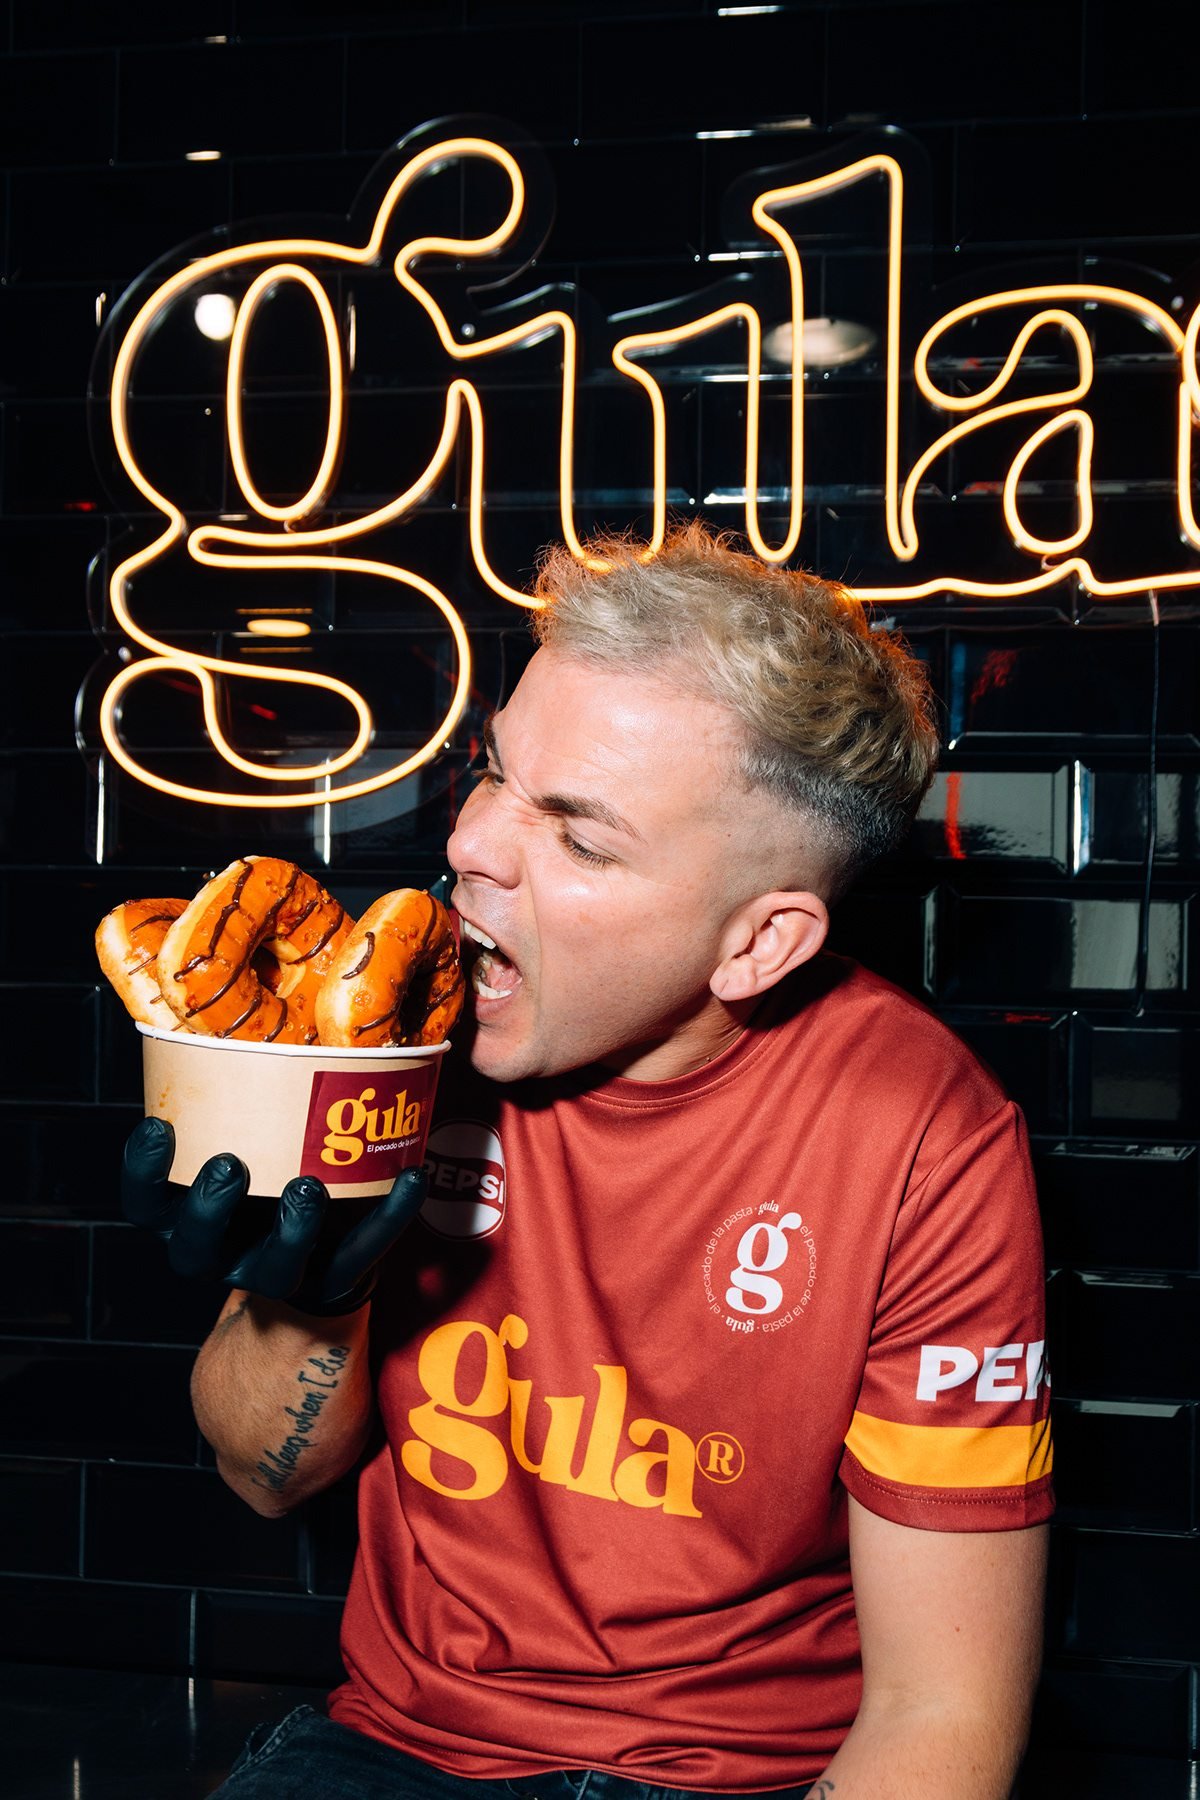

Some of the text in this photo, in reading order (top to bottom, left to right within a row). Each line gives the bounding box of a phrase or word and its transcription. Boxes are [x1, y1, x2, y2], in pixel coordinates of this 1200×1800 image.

[100, 136, 1200, 809] gula
[320, 1087, 421, 1166] gula
[366, 1143, 375, 1153] El
[375, 1141, 398, 1154] pecado
[701, 1200, 780, 1315] el pecado de la pasta gula
[725, 1211, 803, 1315] g
[725, 1225, 818, 1334] el pecado de la pasta gula
[283, 1391, 329, 1434] when
[297, 1370, 339, 1389] I
